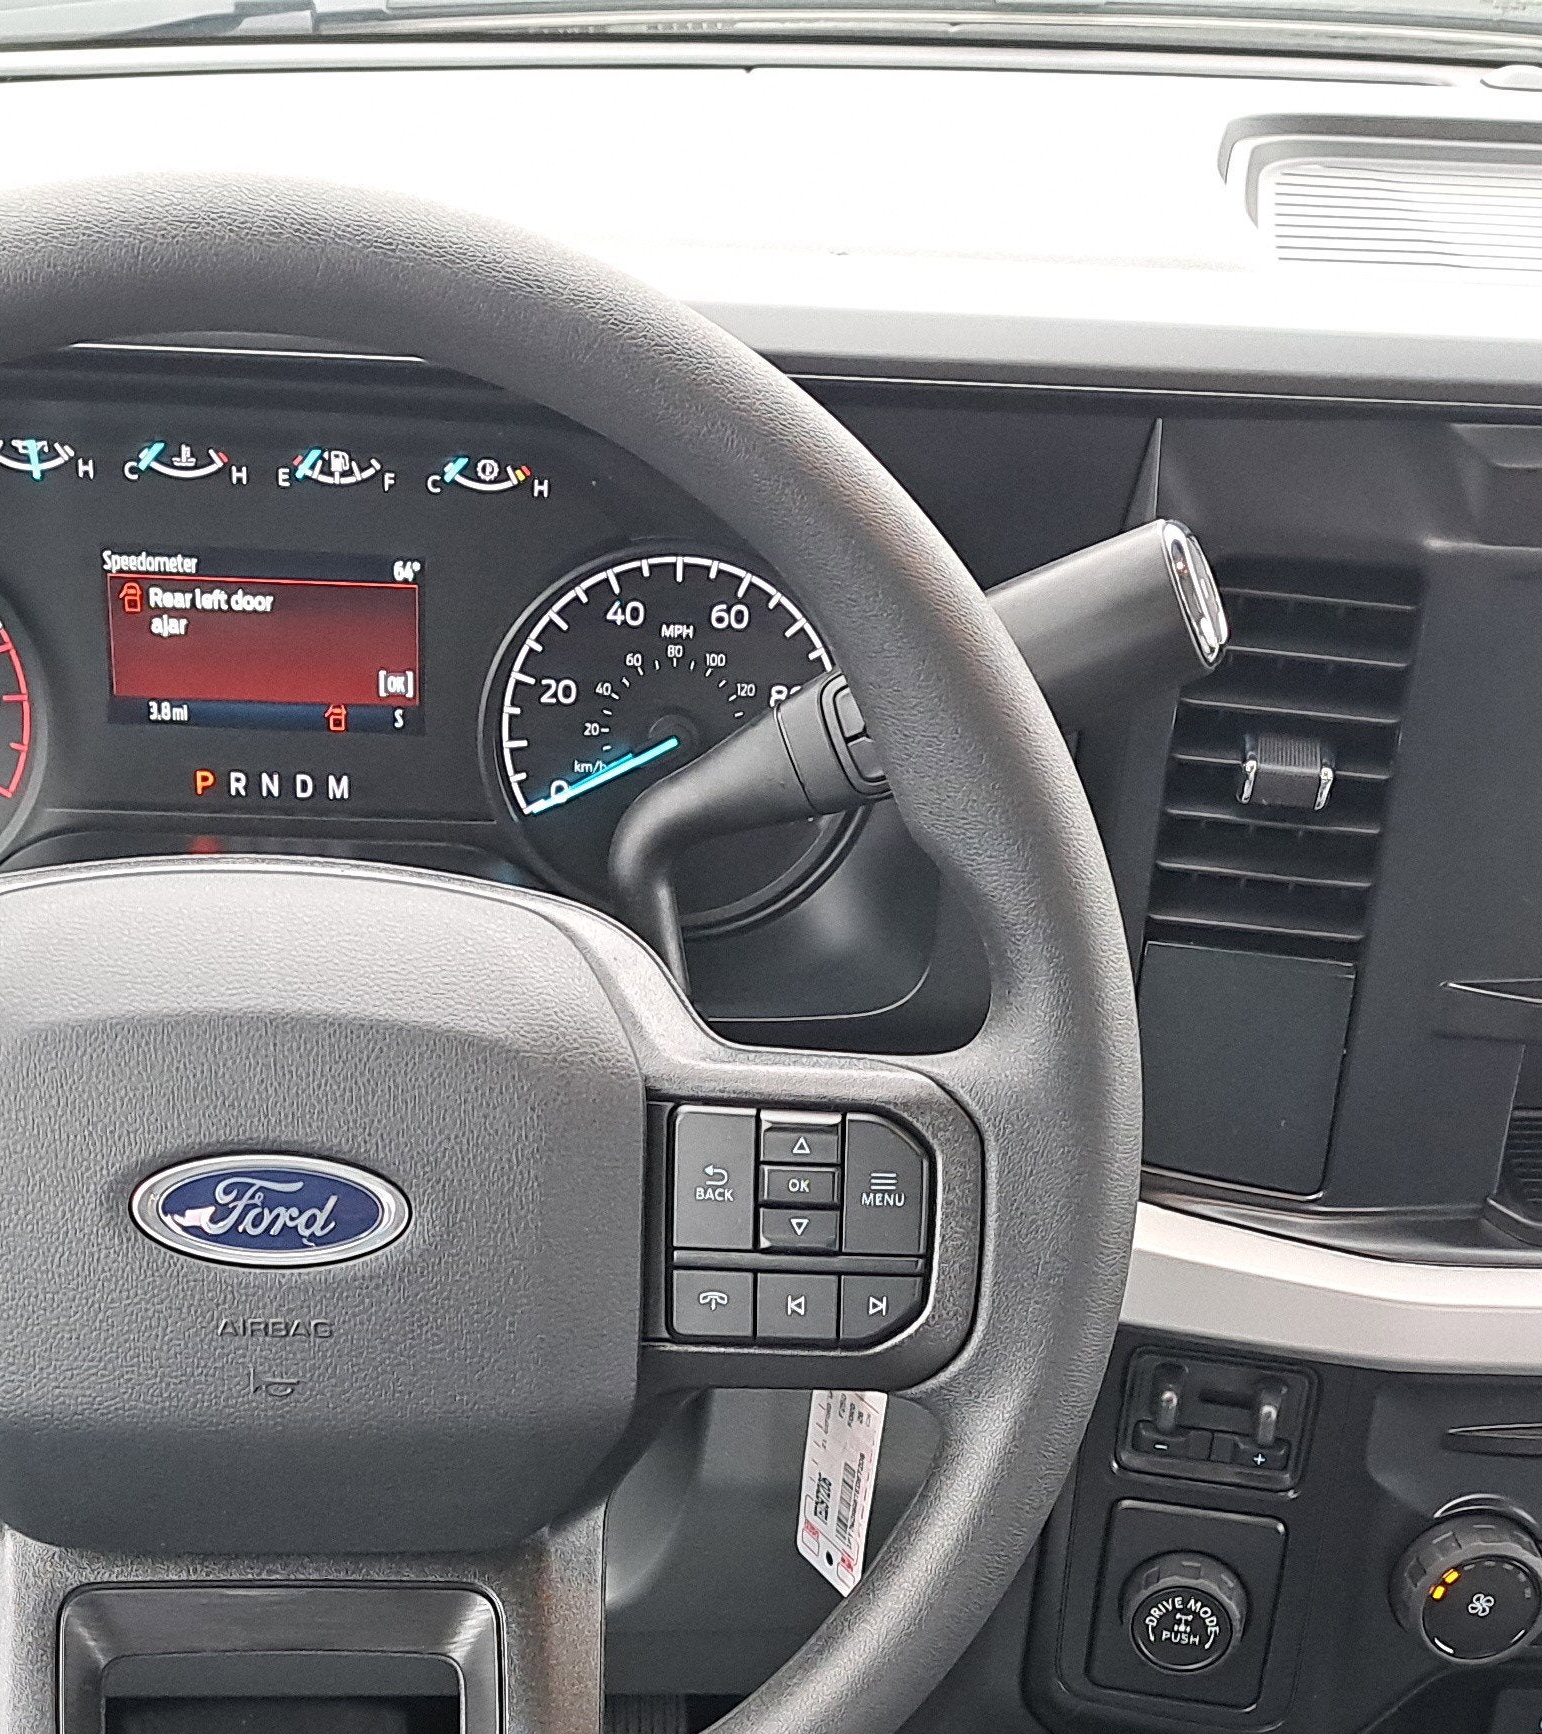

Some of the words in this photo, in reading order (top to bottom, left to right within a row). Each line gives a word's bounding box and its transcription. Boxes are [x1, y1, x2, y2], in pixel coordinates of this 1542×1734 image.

[77, 460, 94, 479] H
[124, 461, 138, 480] C
[231, 466, 247, 485] H
[278, 467, 290, 486] E
[384, 472, 396, 491] F
[427, 474, 441, 493] C
[534, 479, 549, 498] H
[103, 550, 198, 573] Speedometer
[149, 587, 192, 609] Rear
[194, 588, 228, 610] left
[231, 589, 274, 612] door
[606, 600, 645, 626] 40
[711, 604, 749, 629] 60
[151, 614, 189, 637] ajar
[661, 624, 694, 639] MPH
[626, 653, 642, 667] 60
[667, 645, 683, 658] 80
[705, 653, 726, 667] 100
[540, 679, 577, 704] 20
[595, 683, 612, 696] 40
[736, 683, 756, 697] 120
[769, 685, 801, 708] 8
[583, 722, 600, 736] 20
[195, 770, 214, 795] P
[230, 771, 247, 797] R
[261, 772, 279, 797] N
[295, 774, 313, 798] D
[328, 775, 349, 799] M
[696, 1187, 734, 1202] BACK
[788, 1179, 810, 1193] OK
[861, 1192, 905, 1207] MENU
[173, 1176, 340, 1246] Ford
[217, 1318, 335, 1339] AIRBAG
[1145, 1596, 1184, 1627] DRIVE
[1187, 1596, 1219, 1636] MODE
[1162, 1630, 1199, 1645] PUSH
